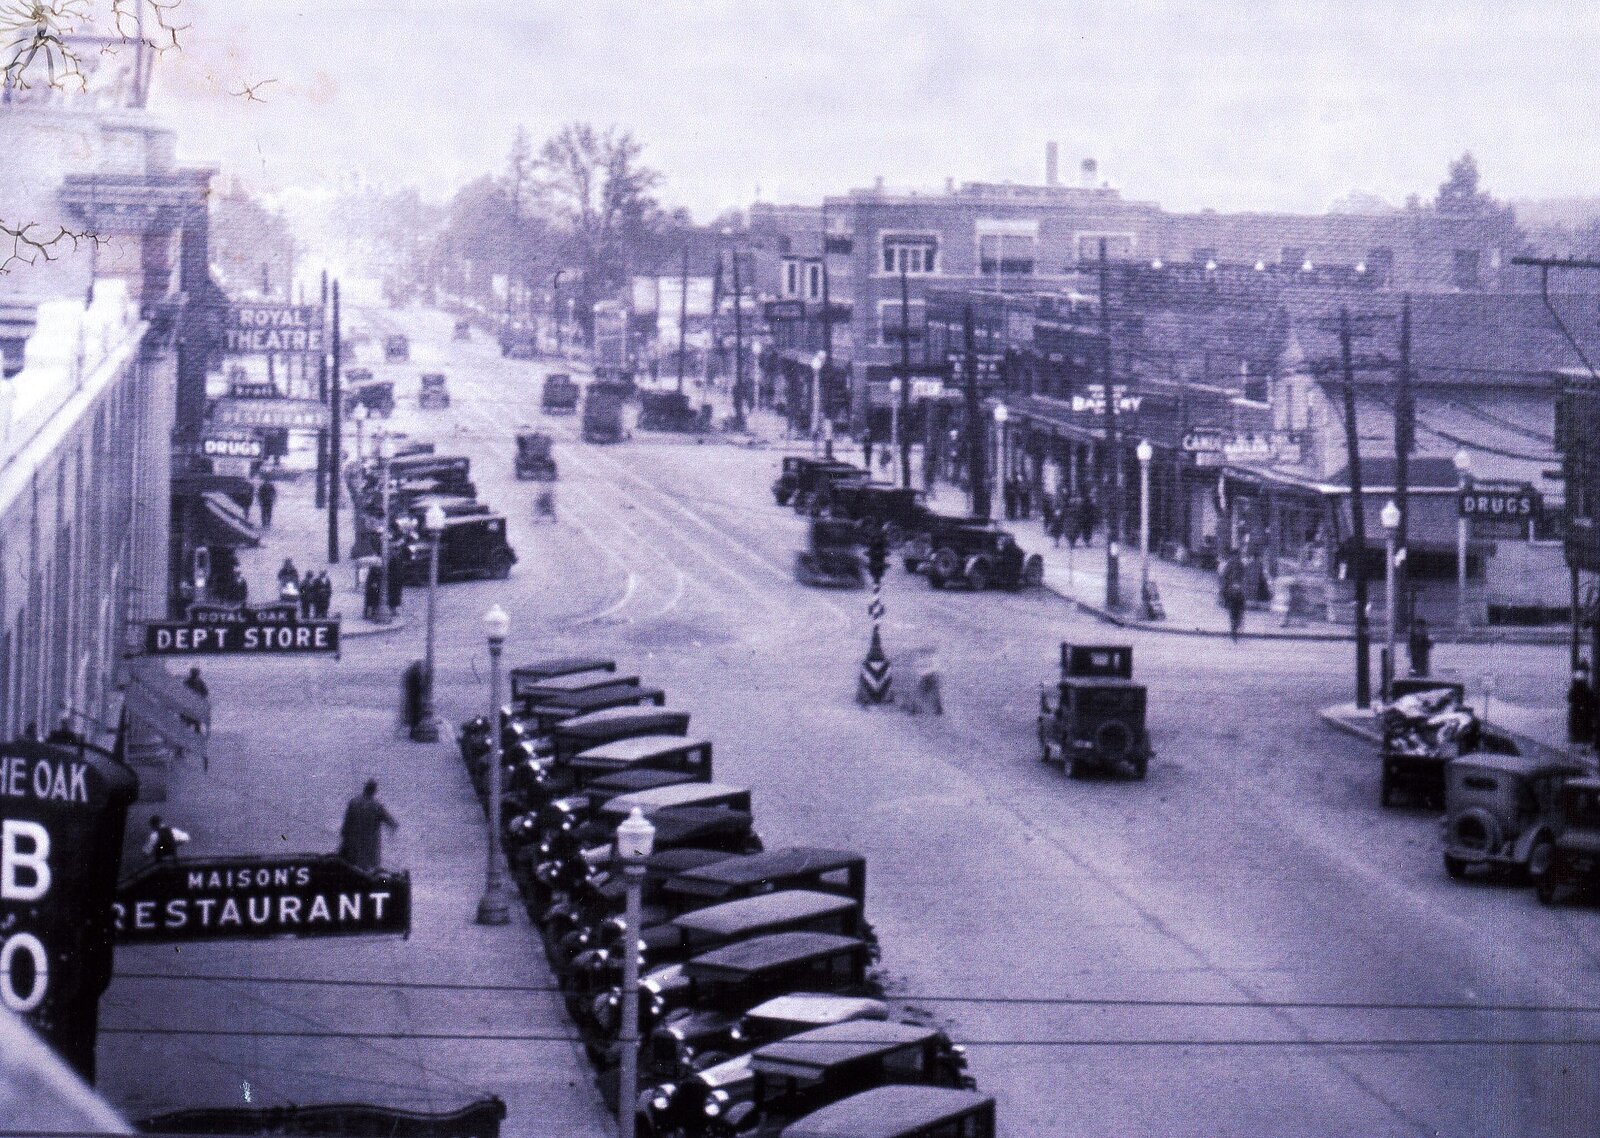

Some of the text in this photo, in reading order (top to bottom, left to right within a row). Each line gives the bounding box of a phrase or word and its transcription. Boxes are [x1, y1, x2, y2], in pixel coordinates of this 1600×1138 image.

[240, 309, 306, 326] ROYAL
[225, 329, 321, 350] THEATRE
[223, 411, 322, 425] RESTAURANT
[205, 440, 261, 456] DRUGS
[1464, 496, 1531, 514] DRUGS
[199, 610, 288, 622] ROYAL OAK
[244, 626, 328, 648] STORE
[33, 759, 88, 802] OAK
[188, 867, 310, 889] MAISON'S
